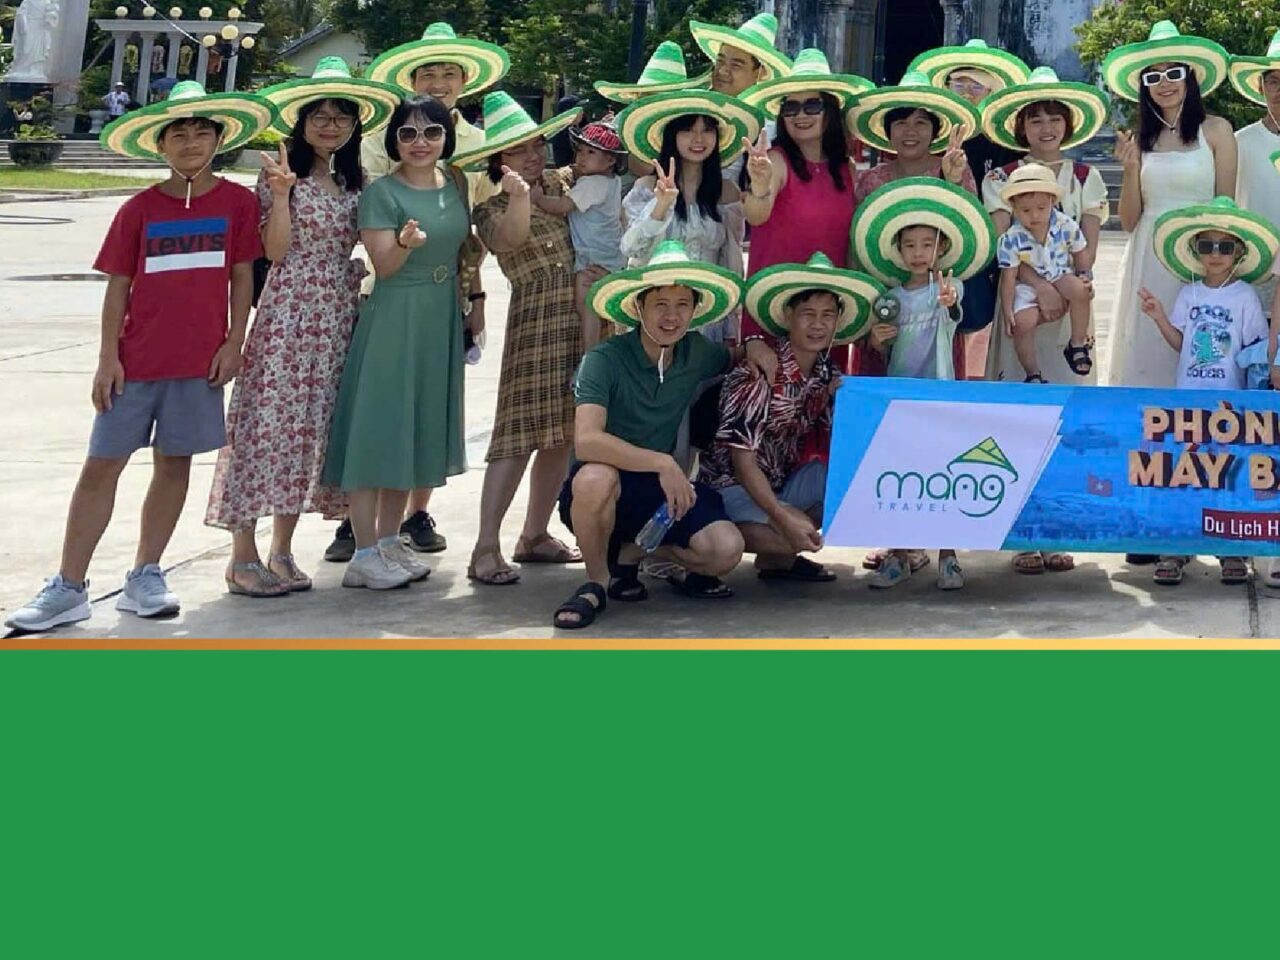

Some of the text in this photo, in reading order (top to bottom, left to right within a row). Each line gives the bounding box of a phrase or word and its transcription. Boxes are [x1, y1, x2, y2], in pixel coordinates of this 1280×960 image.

[1128, 442, 1232, 489] MÁY
[876, 470, 1006, 518] mang
[876, 502, 948, 512] TRAVEL
[1204, 515, 1225, 533] Du
[1230, 516, 1262, 539] Lịch
